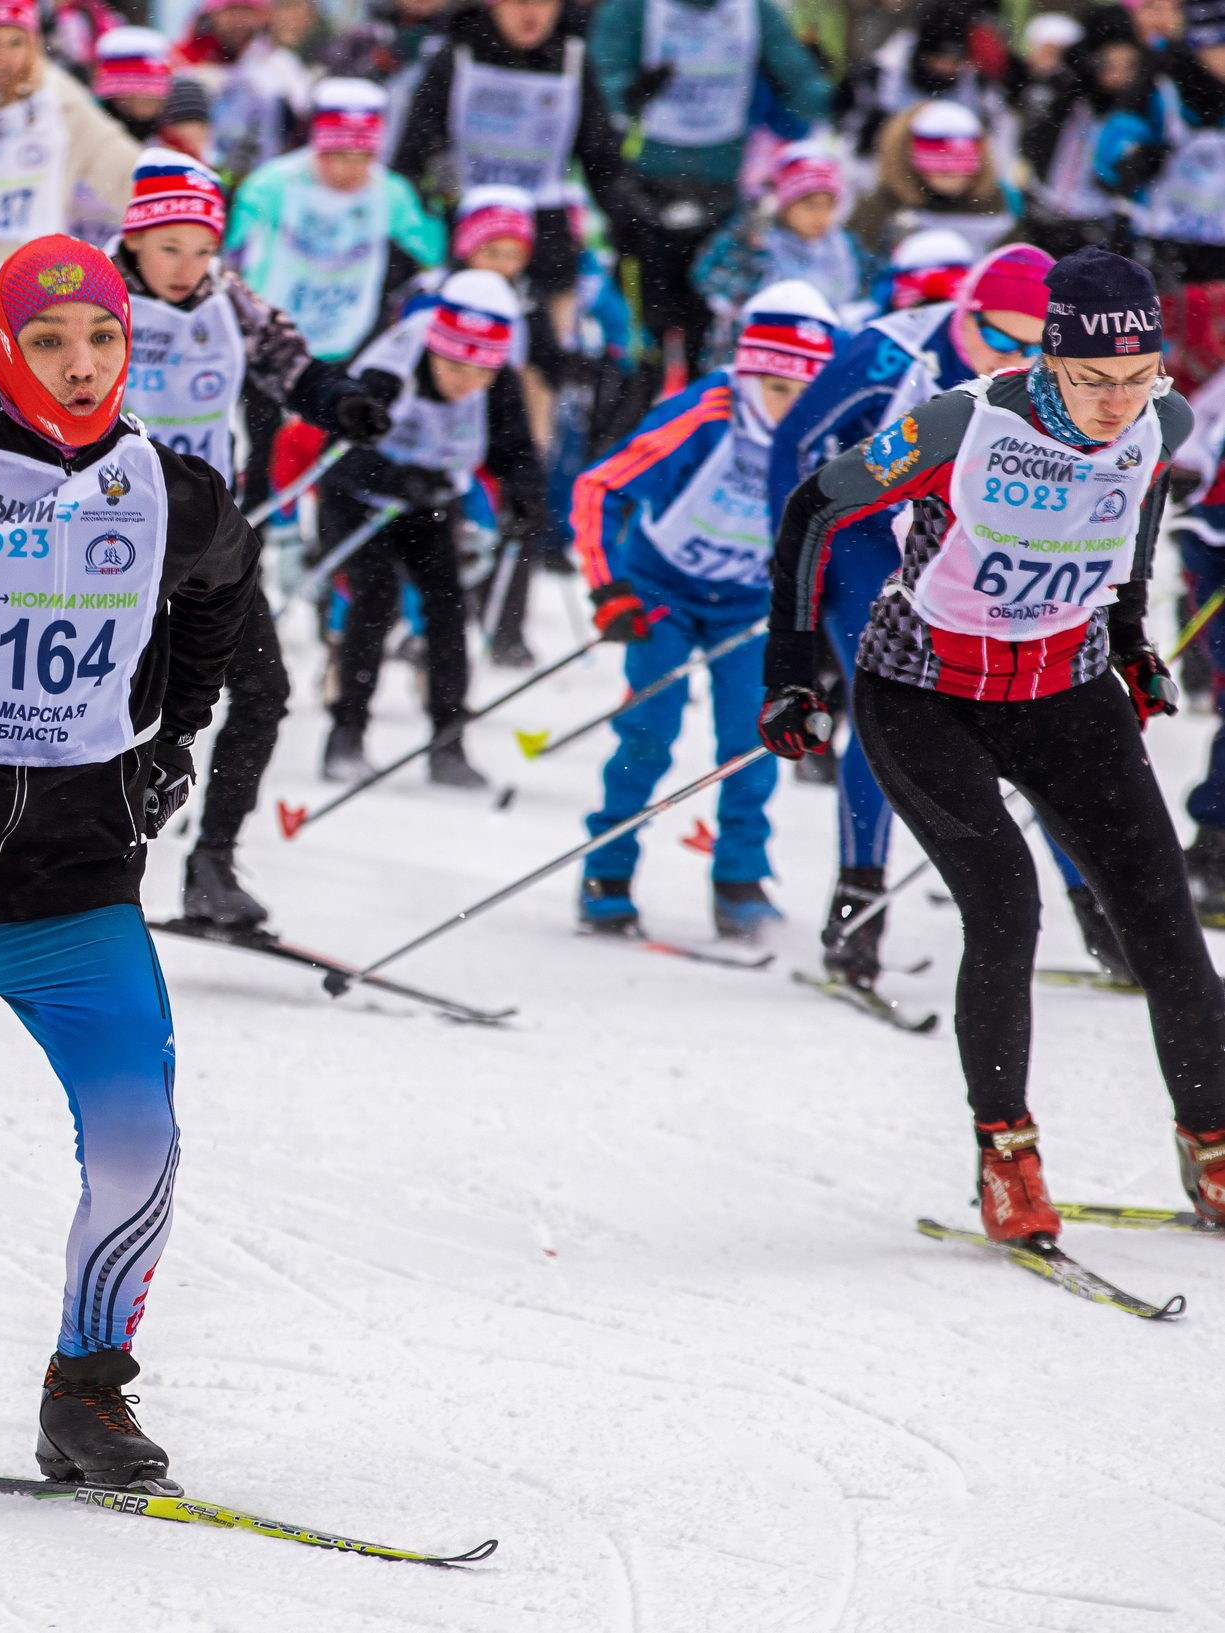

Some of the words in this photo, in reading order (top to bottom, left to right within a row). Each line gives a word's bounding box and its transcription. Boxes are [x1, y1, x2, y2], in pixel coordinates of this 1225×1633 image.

[986, 452, 1074, 482] РОССИИ
[982, 477, 1069, 511] 2023
[973, 523, 1020, 548] СПОРТ
[1029, 538, 1081, 553] НОРМА
[973, 551, 1114, 607] 6707
[10, 592, 77, 610] НОРМА
[78, 592, 139, 610] ЖИЗНИ
[989, 603, 1059, 620] ОБЛАСТЬ
[75, 1487, 149, 1515] FISCHER
